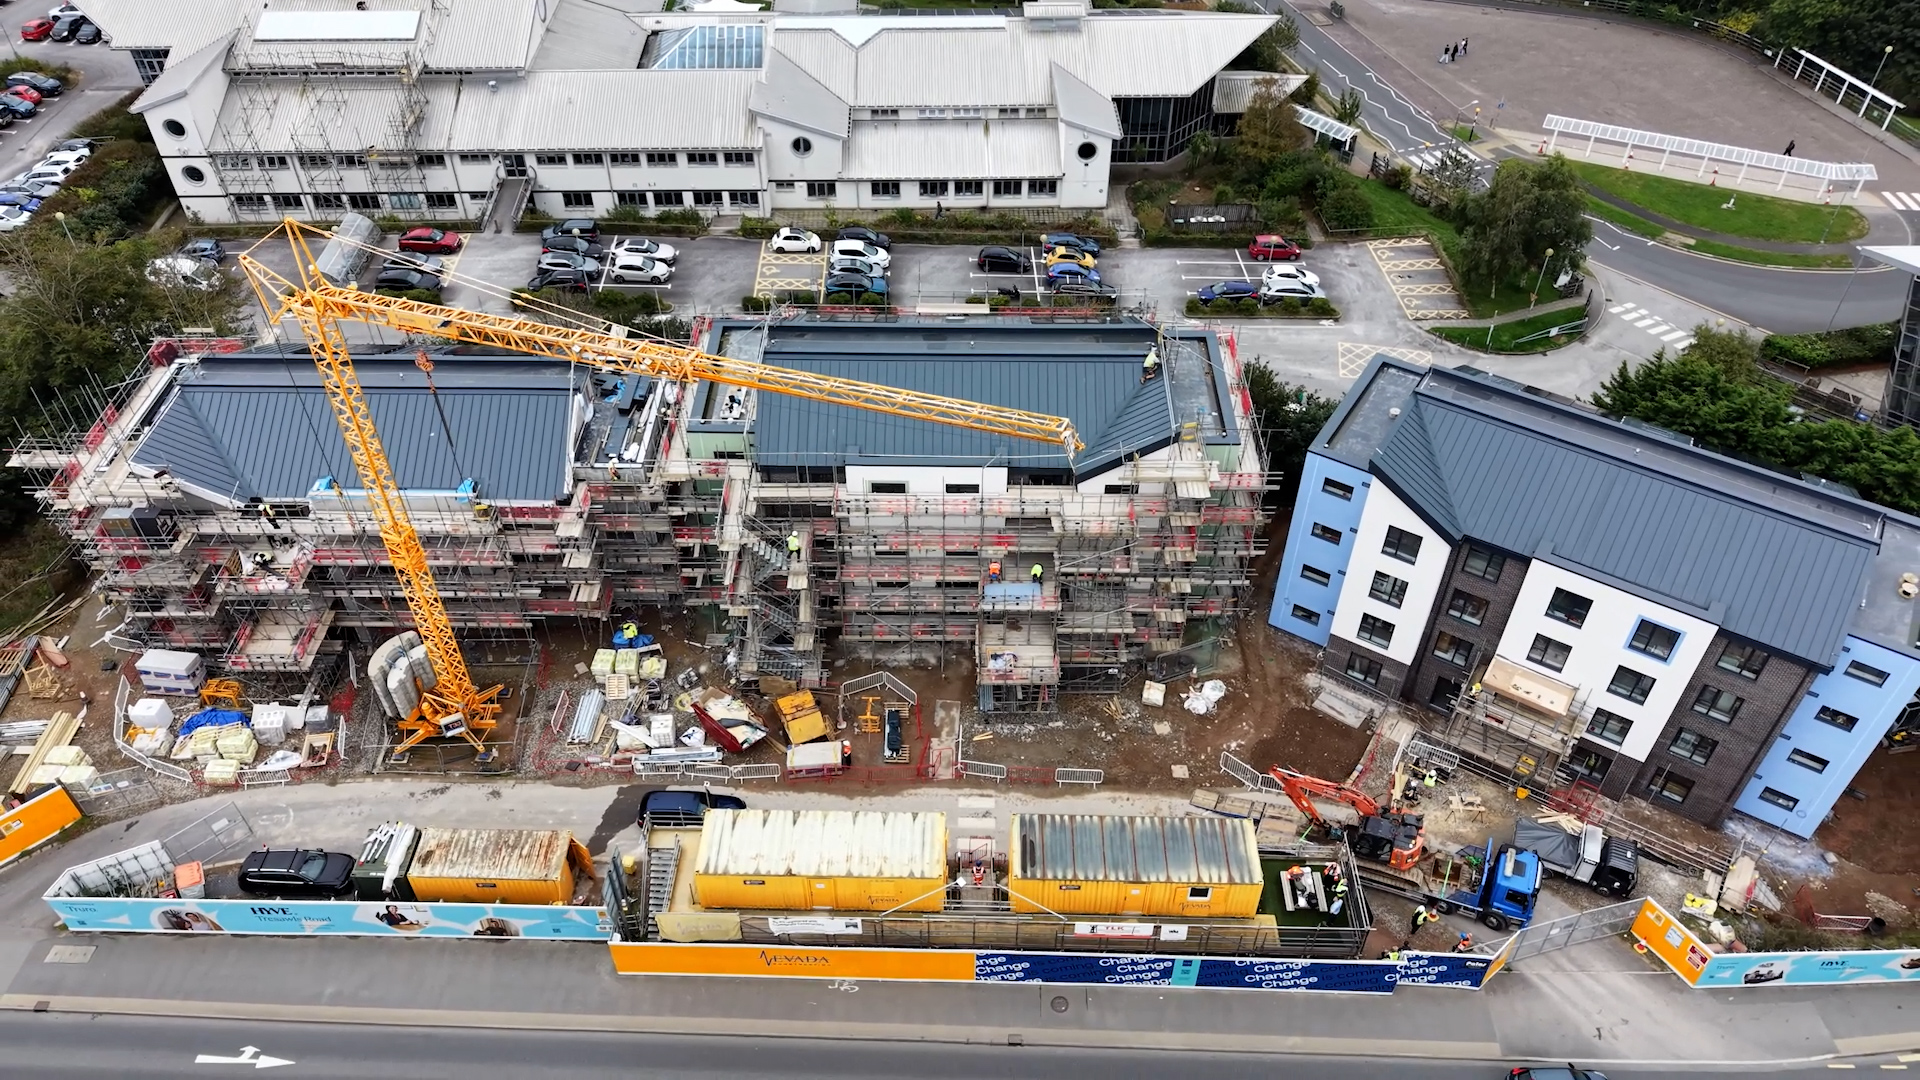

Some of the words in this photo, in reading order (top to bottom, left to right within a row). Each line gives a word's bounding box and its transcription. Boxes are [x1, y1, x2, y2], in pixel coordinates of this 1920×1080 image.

[759, 950, 830, 967] NEVADA
[976, 961, 1030, 974] Change
[1117, 960, 1173, 973] Change
[1105, 970, 1160, 983] Change
[1245, 969, 1301, 983] Change
[1262, 975, 1318, 988] Change
